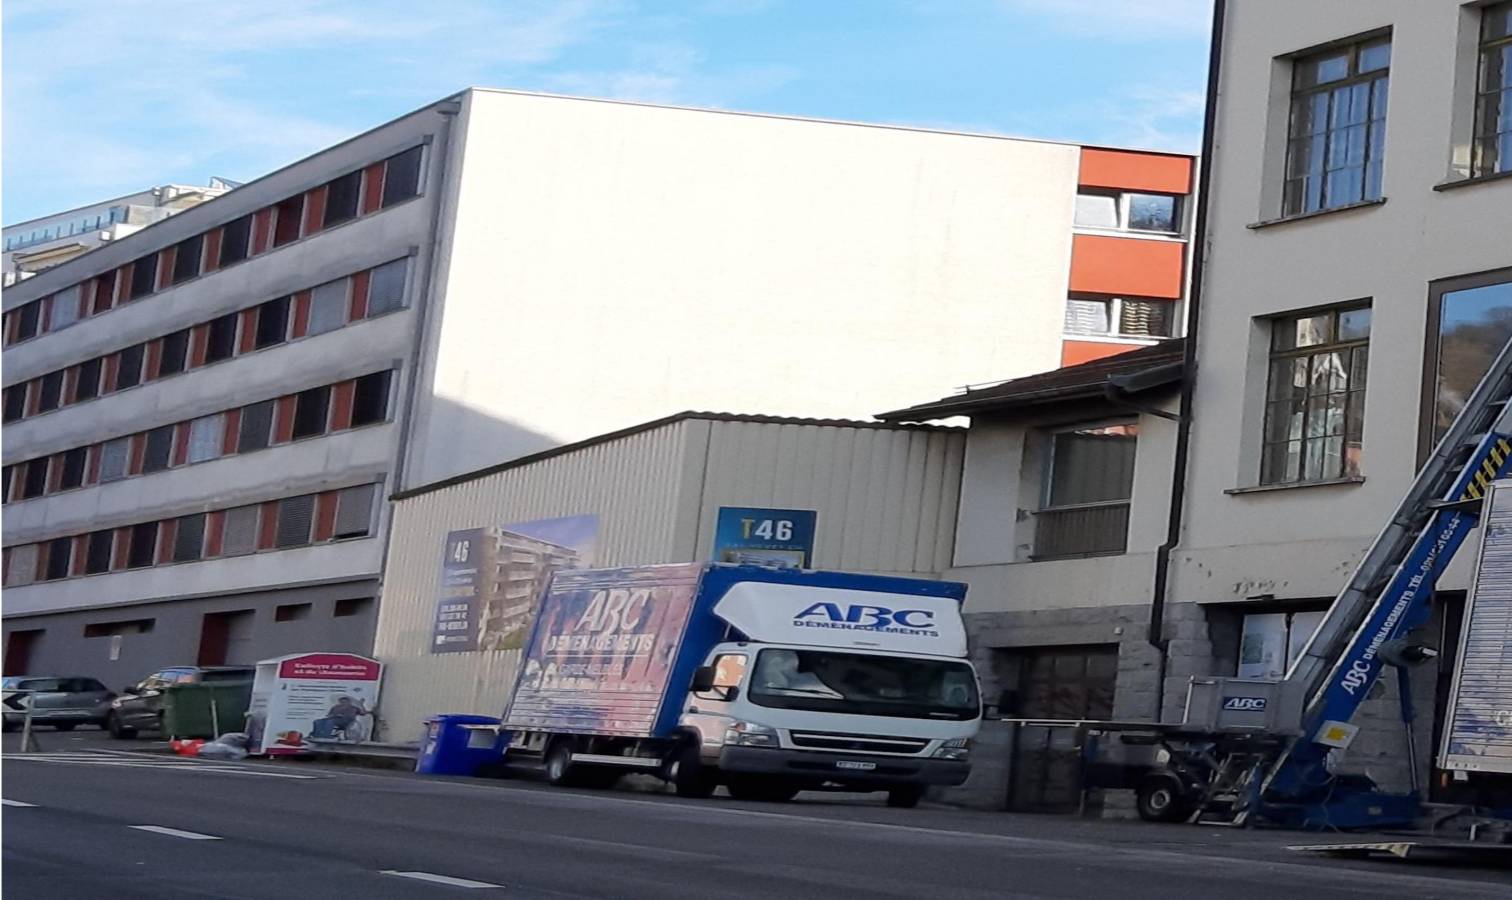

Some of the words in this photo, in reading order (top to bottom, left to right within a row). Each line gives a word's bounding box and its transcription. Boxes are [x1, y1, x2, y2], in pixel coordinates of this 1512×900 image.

[741, 518, 793, 542] T46
[575, 589, 650, 633] ABC
[794, 602, 935, 628] ABC
[1340, 659, 1372, 696] ABC
[1224, 697, 1267, 710] ABC
